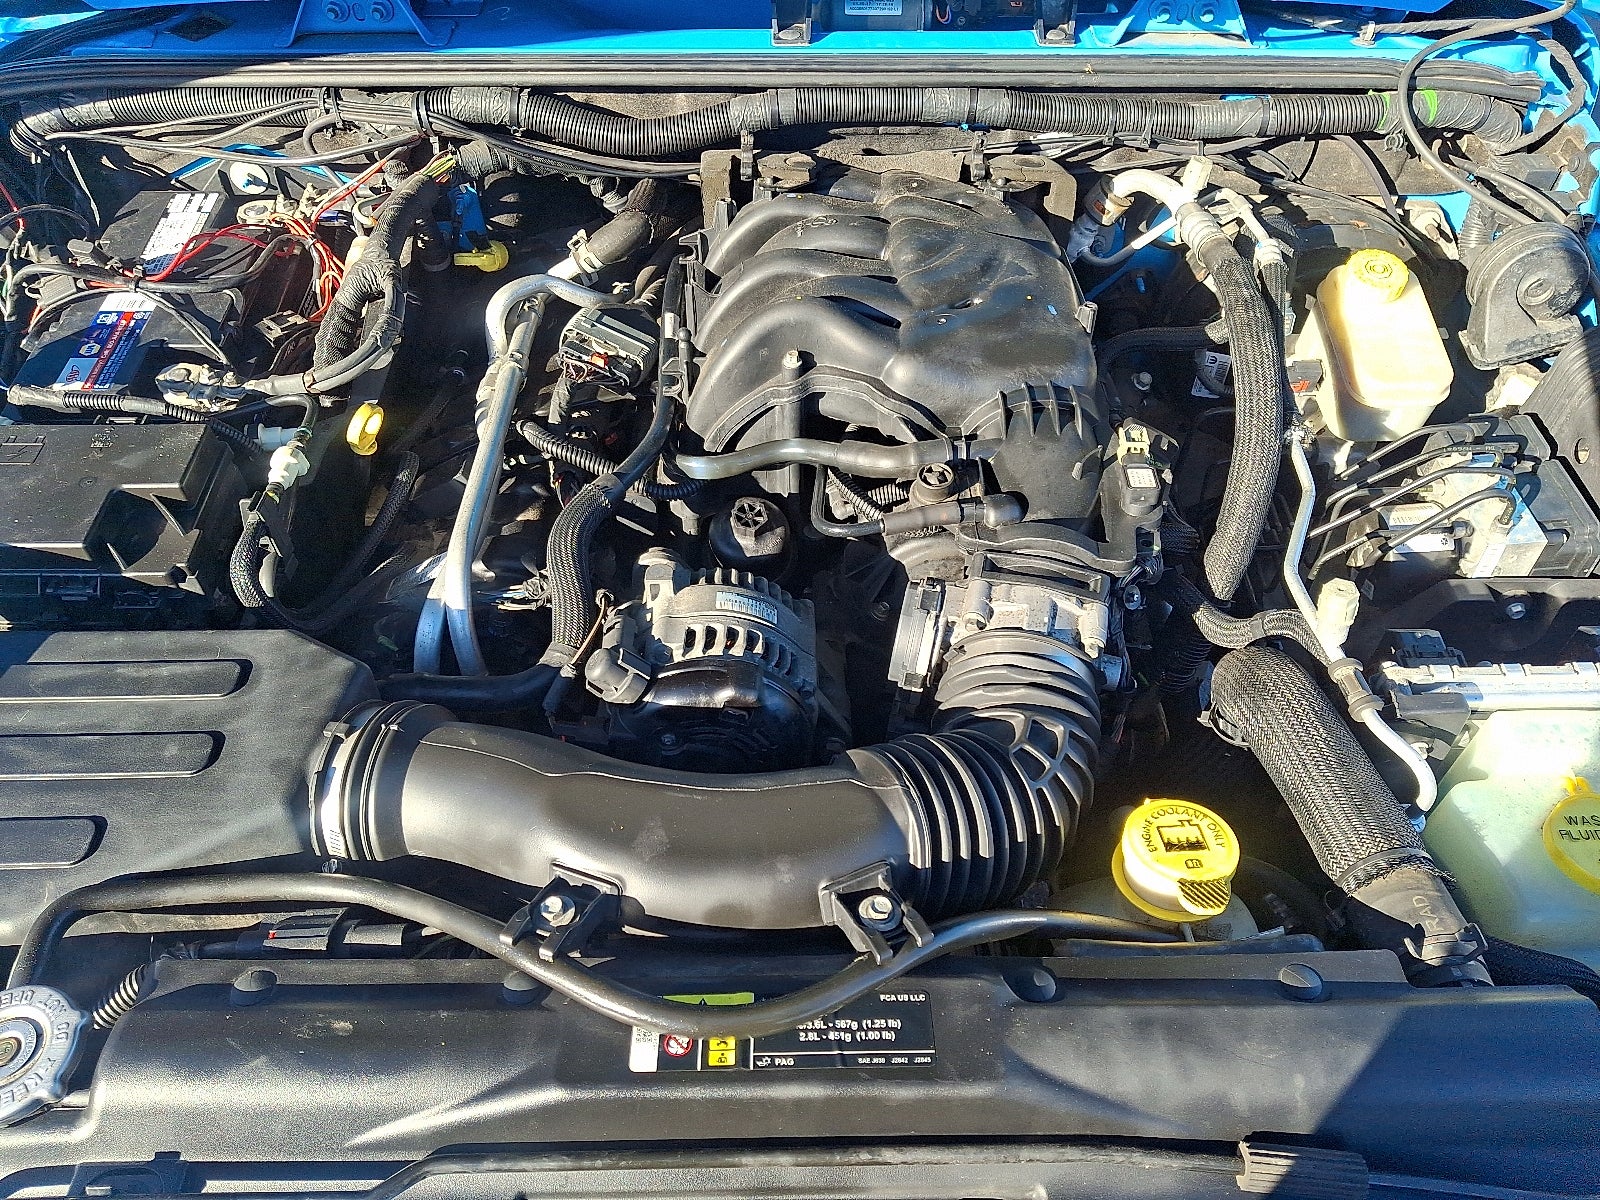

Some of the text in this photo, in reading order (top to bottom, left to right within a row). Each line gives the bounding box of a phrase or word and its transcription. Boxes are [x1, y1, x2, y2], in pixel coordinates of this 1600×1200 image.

[1563, 815, 1600, 826] WAS
[1142, 807, 1226, 853] ENGINE COOLANT ONLY
[1412, 895, 1445, 932] RAD
[880, 994, 926, 1002] FCA US LLC
[862, 1019, 887, 1031] (1.25
[887, 1019, 902, 1030] lb)
[799, 1031, 821, 1042] 2.8L
[855, 1030, 881, 1043] (1.00
[881, 1030, 896, 1042] lb)
[774, 1057, 795, 1066] PAG
